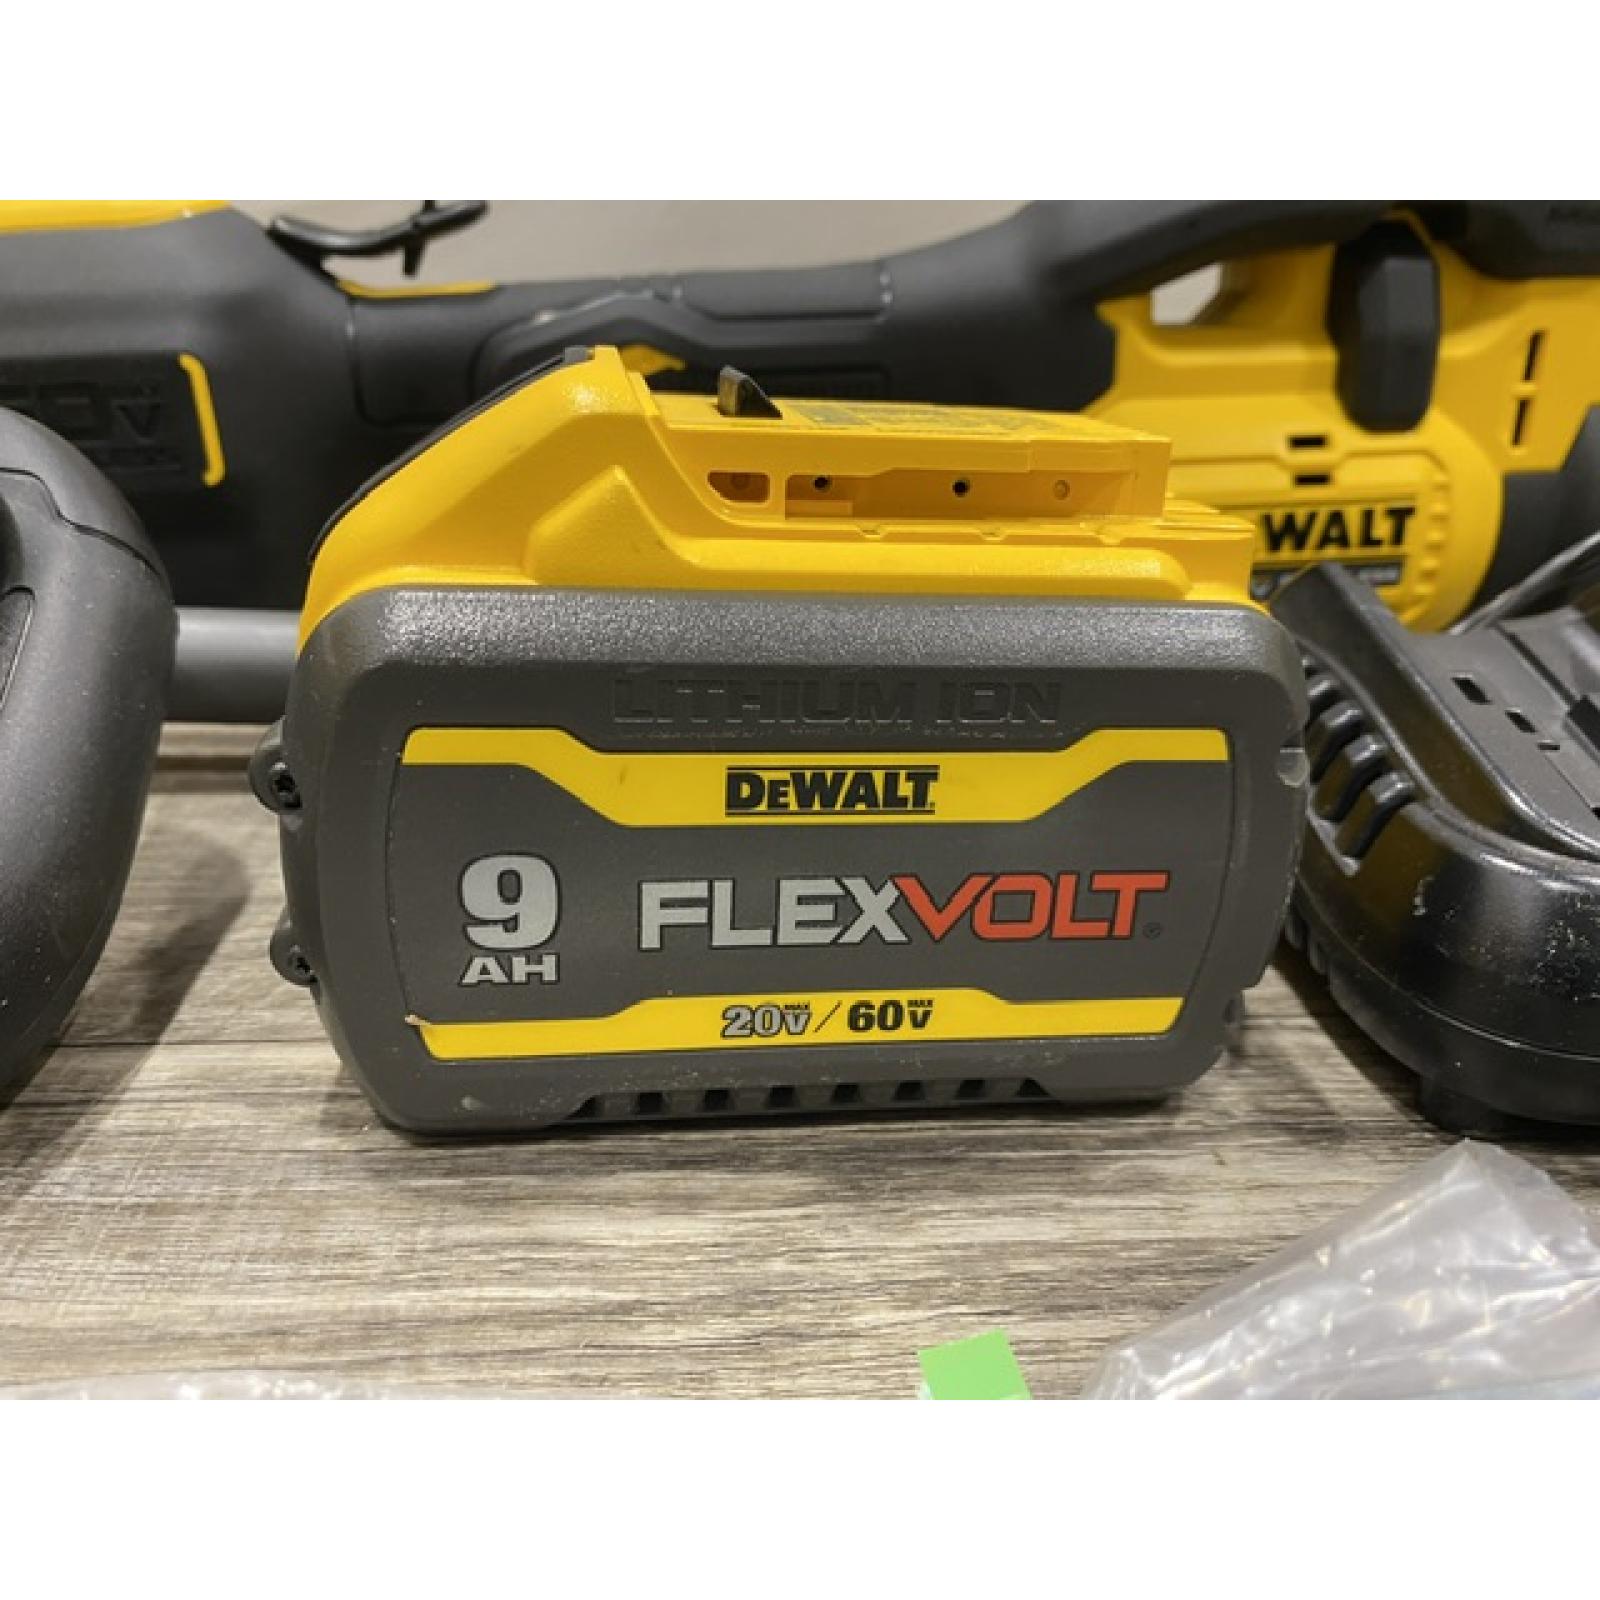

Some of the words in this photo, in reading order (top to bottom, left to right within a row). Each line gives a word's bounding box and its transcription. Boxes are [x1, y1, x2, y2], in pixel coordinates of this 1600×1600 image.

[1259, 505, 1415, 552] WALT
[612, 679, 917, 724] LITHIUM
[935, 680, 1062, 724] ION
[459, 852, 561, 951] 9
[638, 869, 1168, 950] FLEXVOLT
[458, 953, 561, 986] AH
